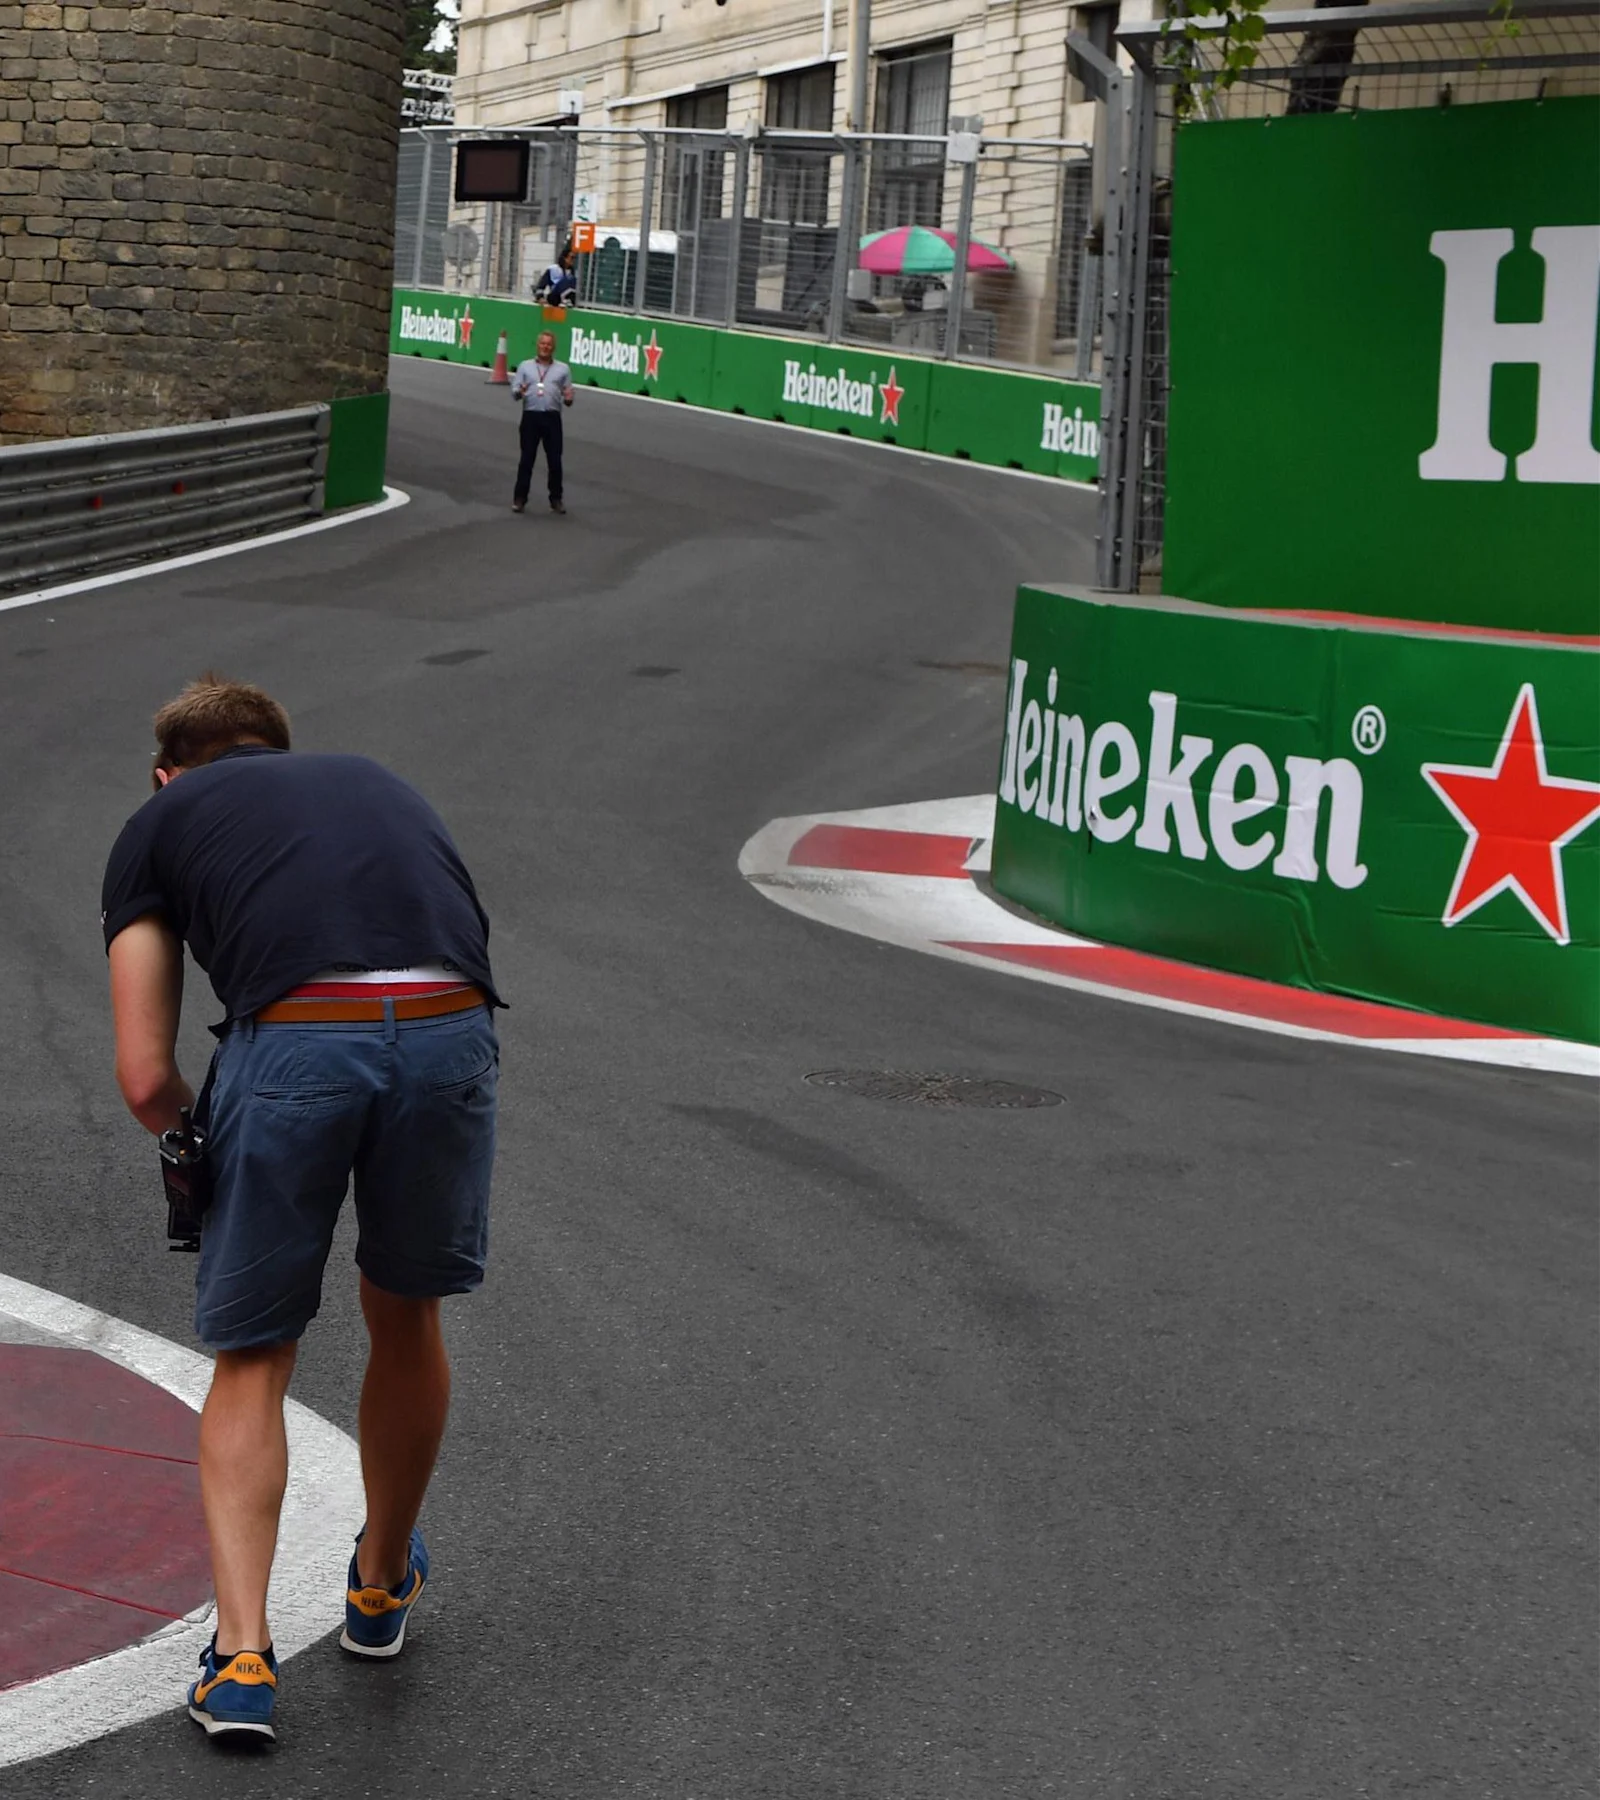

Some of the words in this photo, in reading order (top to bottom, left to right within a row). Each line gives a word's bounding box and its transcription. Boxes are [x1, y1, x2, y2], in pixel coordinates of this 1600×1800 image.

[574, 225, 591, 249] F
[569, 327, 640, 374] Heineken
[1418, 224, 1600, 484] H
[782, 360, 874, 417] Heineken
[1040, 402, 1101, 458] Hein
[361, 1595, 385, 1609] NIKE
[235, 1662, 262, 1675] NIKE
